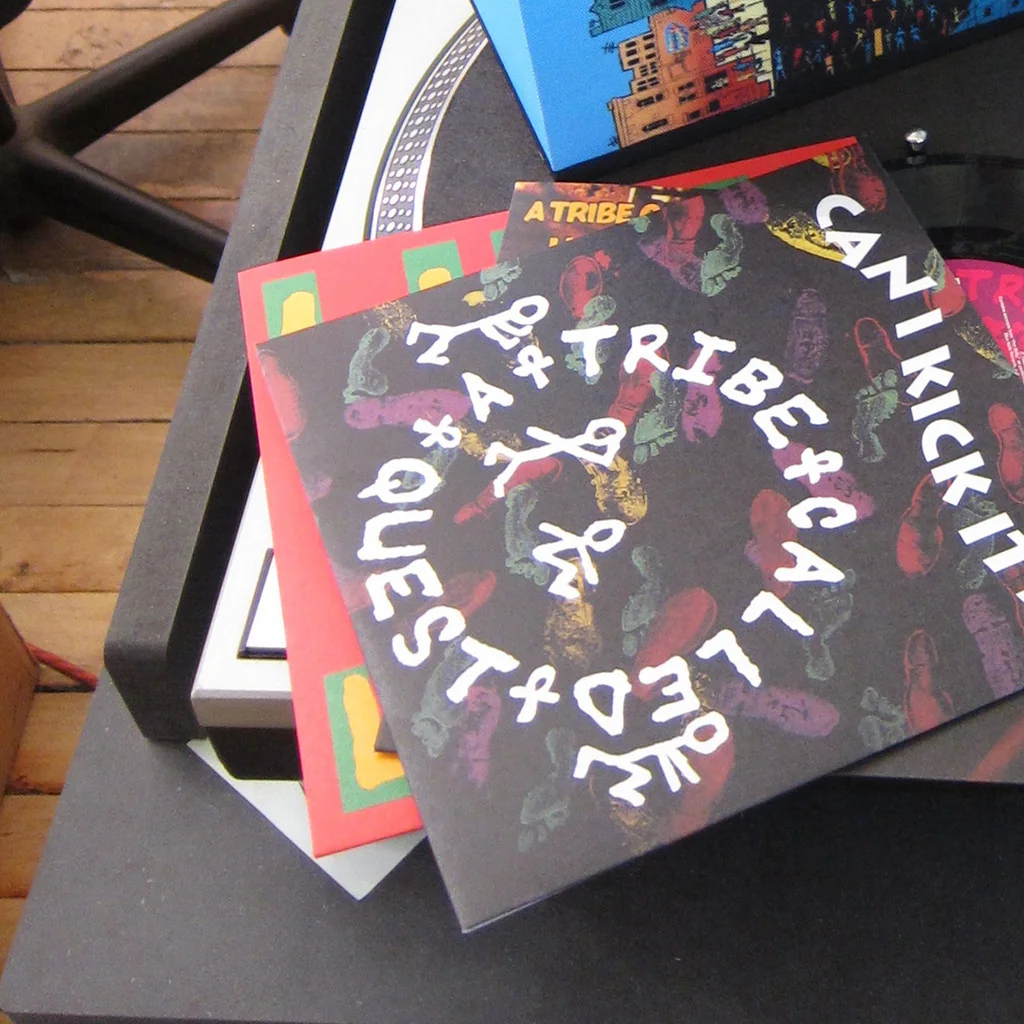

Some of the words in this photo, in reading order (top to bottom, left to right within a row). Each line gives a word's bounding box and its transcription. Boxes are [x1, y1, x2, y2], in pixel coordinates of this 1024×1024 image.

[523, 200, 545, 223] A
[550, 200, 636, 225] TRIBE
[815, 193, 938, 301] CAN
[895, 307, 944, 339] I
[462, 372, 514, 423] A
[561, 322, 830, 449] TRIBE
[900, 344, 993, 508] KICK
[356, 457, 520, 704] QUEST
[572, 495, 858, 736] CALLED
